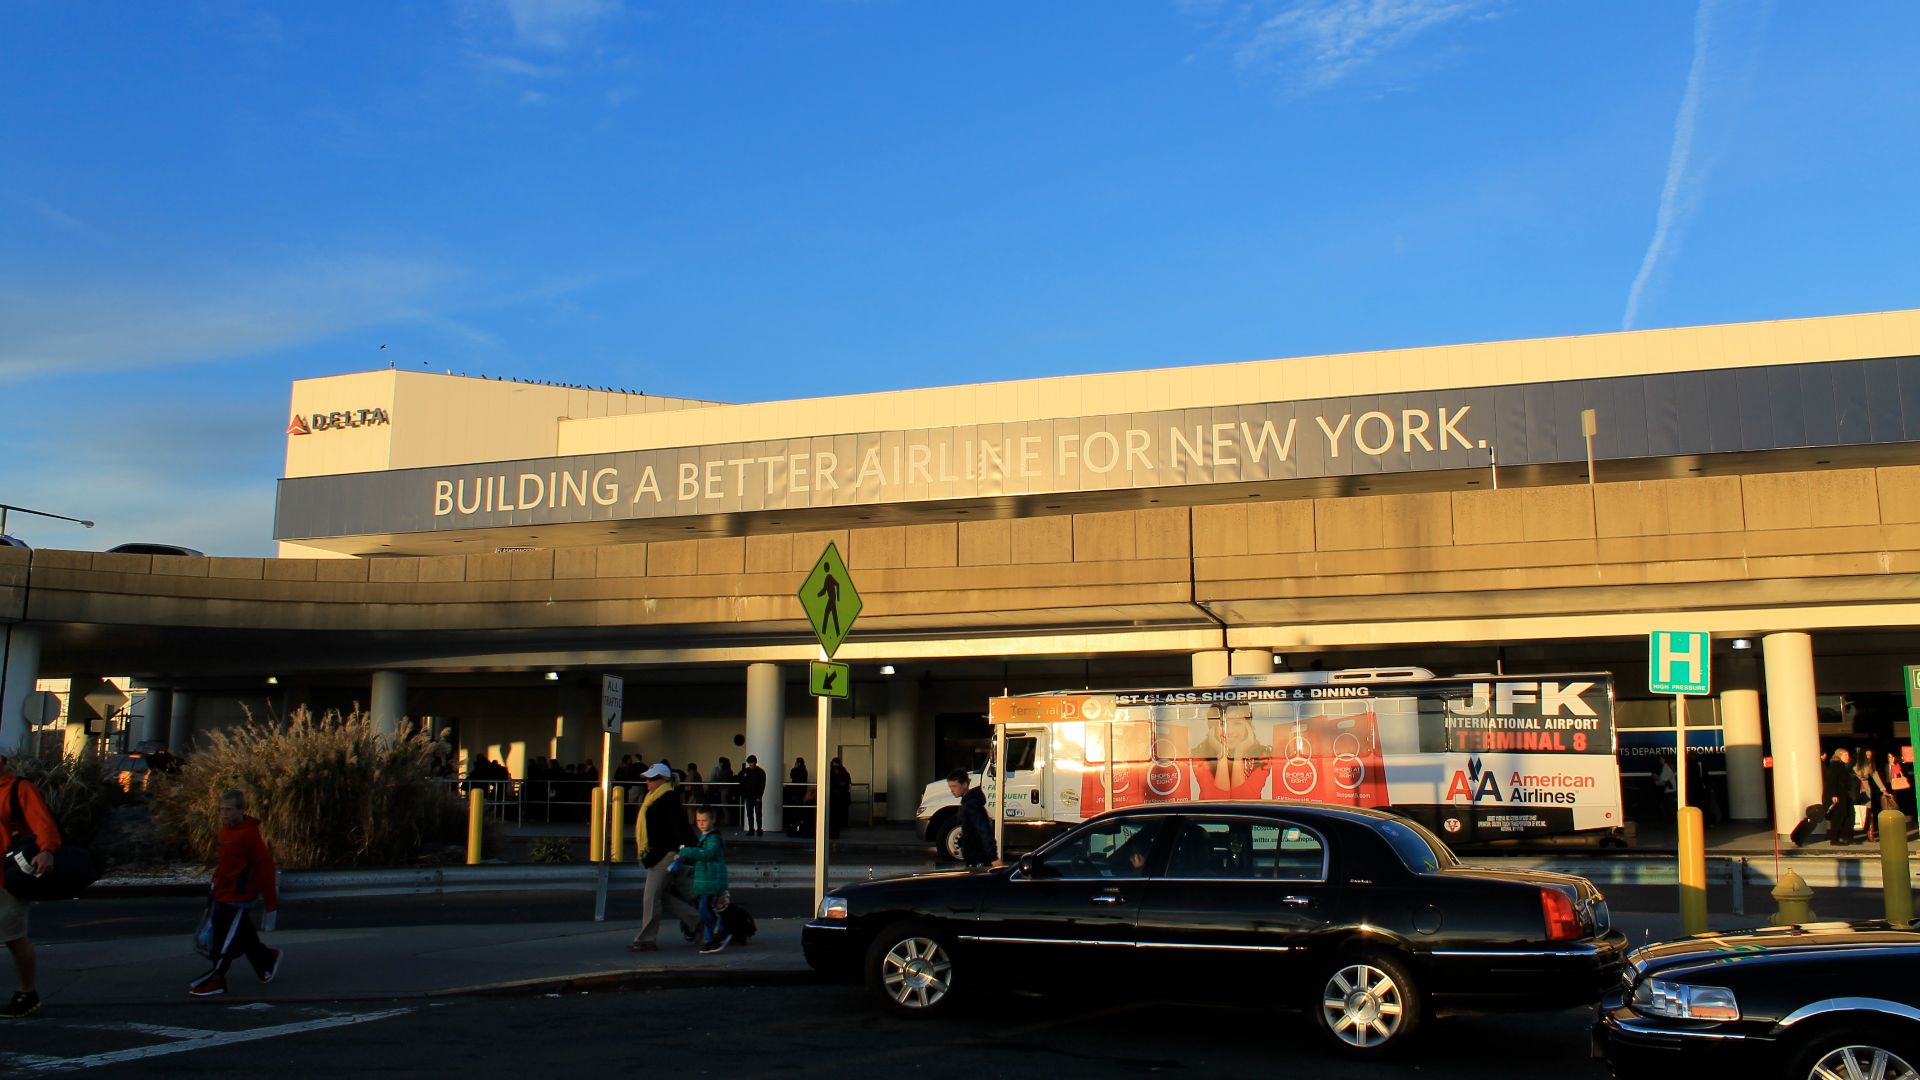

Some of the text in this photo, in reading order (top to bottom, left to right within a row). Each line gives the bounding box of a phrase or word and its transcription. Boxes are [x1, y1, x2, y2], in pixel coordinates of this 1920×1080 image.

[312, 408, 387, 430] DELTA
[434, 405, 1487, 516] BUILDING A BETTER AIRLINE FOR NEW YORK.
[1659, 633, 1701, 684] H
[607, 680, 619, 693] ALL
[1144, 692, 1197, 704] CLASS
[1201, 689, 1287, 701] SHOPPING
[1293, 689, 1305, 699] &
[1310, 686, 1369, 698] DINING
[1448, 682, 1598, 716] JFK
[1444, 717, 1599, 730] INTERNATIONAL AIRPORT
[1456, 731, 1587, 752] TERMINAL 8
[1631, 747, 1677, 756] DEPARTIN
[1509, 771, 1596, 788] American
[1509, 788, 1576, 804] Airlines
